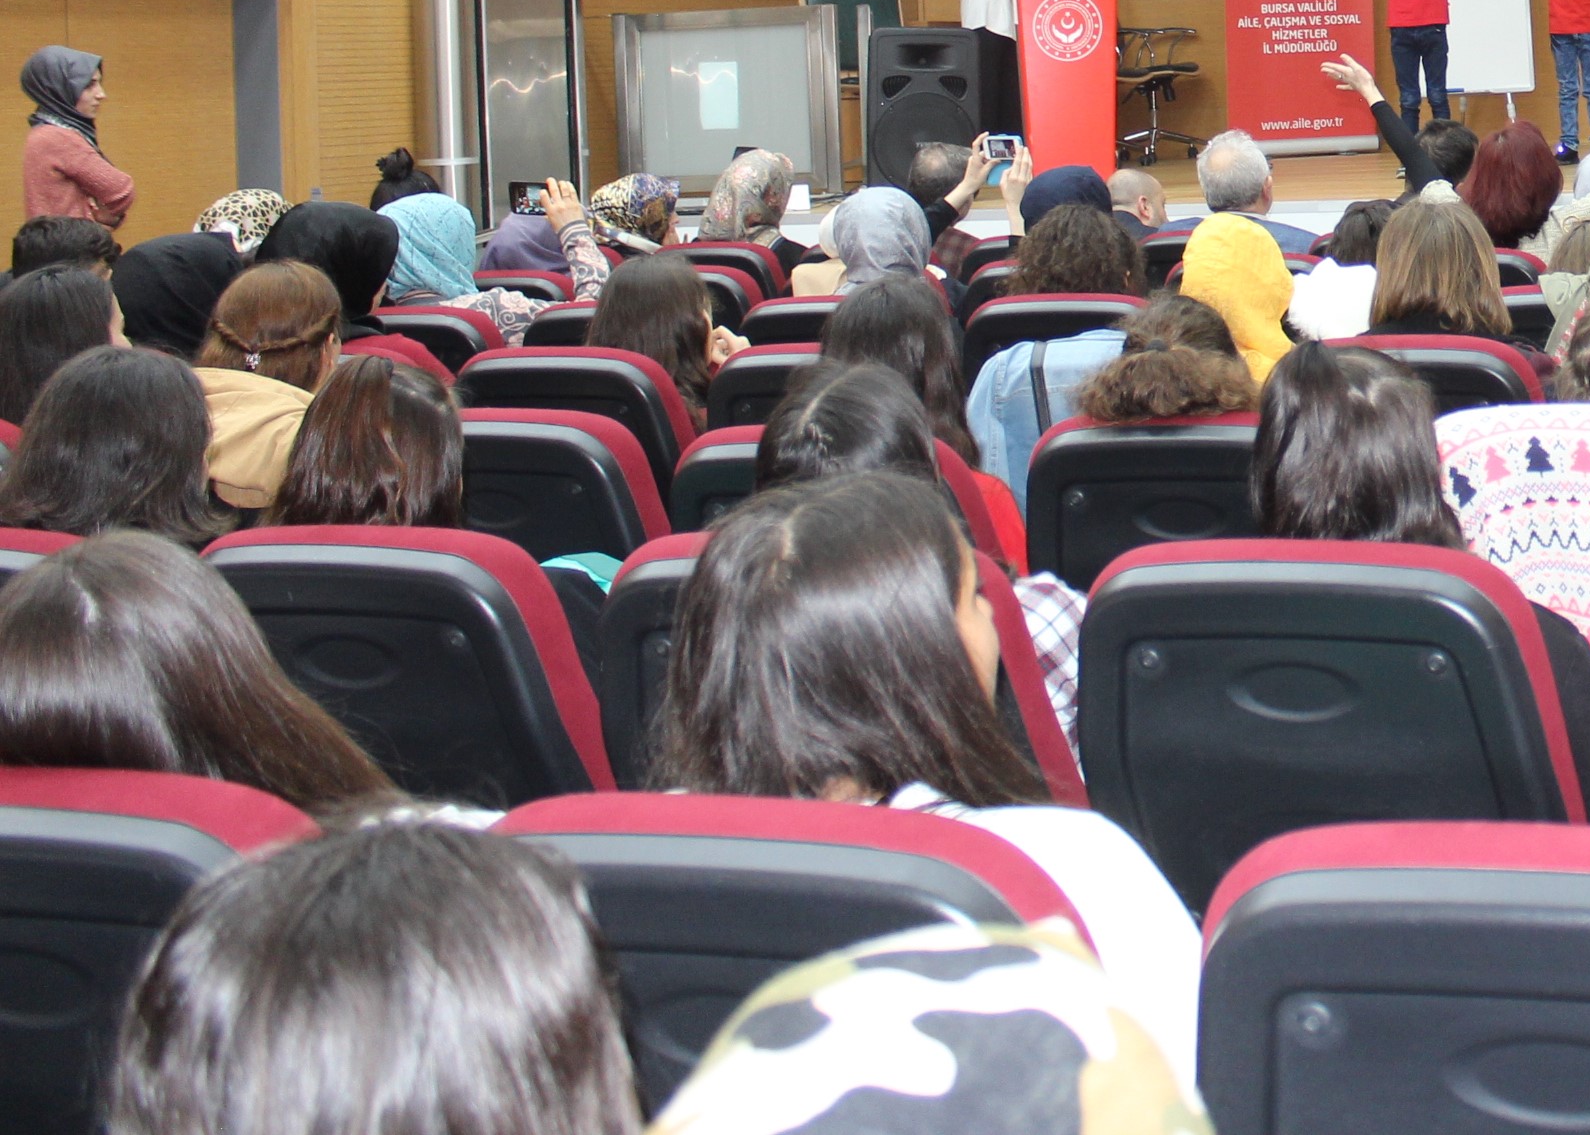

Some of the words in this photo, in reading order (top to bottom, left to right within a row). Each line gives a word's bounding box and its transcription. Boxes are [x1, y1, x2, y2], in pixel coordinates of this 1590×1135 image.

[1261, 3, 1295, 14] BURSA
[1297, 0, 1337, 13] VALİLİĞİ
[1238, 16, 1261, 28] AİLE,
[1264, 16, 1307, 29] ÇALIŞMA
[1309, 15, 1322, 25] VE
[1324, 14, 1361, 25] SOSYAL
[1272, 28, 1327, 40] HİZMETLER
[1263, 42, 1272, 54] İL
[1274, 39, 1337, 54] MÜDÜRLÜĞÜ
[1261, 116, 1343, 130] www.aile.gov.tr
